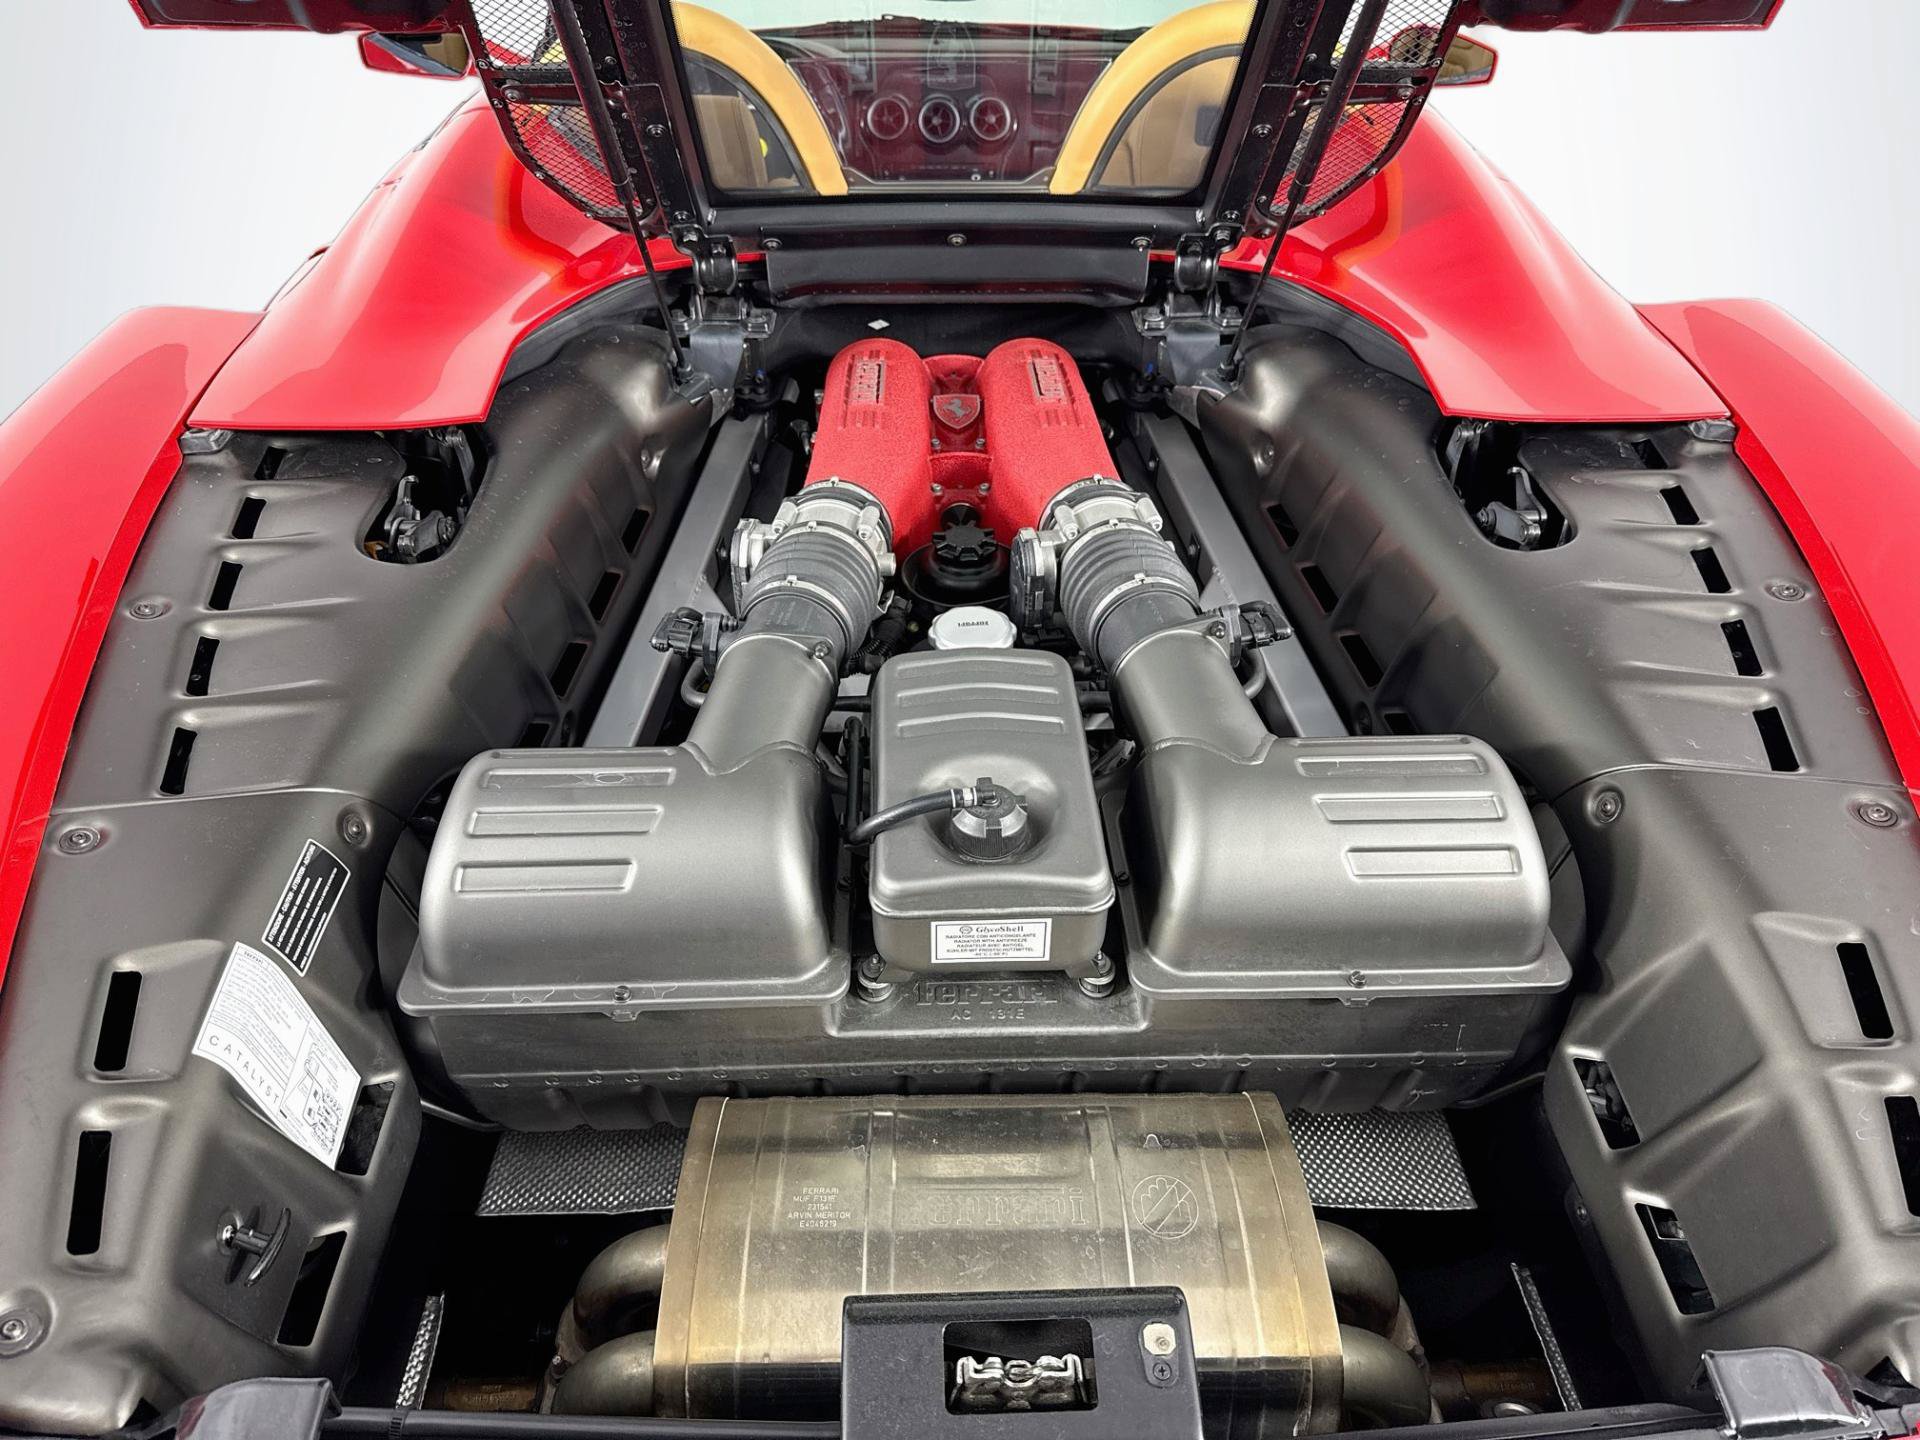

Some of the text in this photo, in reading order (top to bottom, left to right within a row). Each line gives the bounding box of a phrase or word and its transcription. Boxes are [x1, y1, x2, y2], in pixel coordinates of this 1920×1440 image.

[209, 1035, 280, 1104] CATALYST
[802, 1187, 839, 1195] FERRARI
[788, 1211, 851, 1219] ARVIN MERITOR
